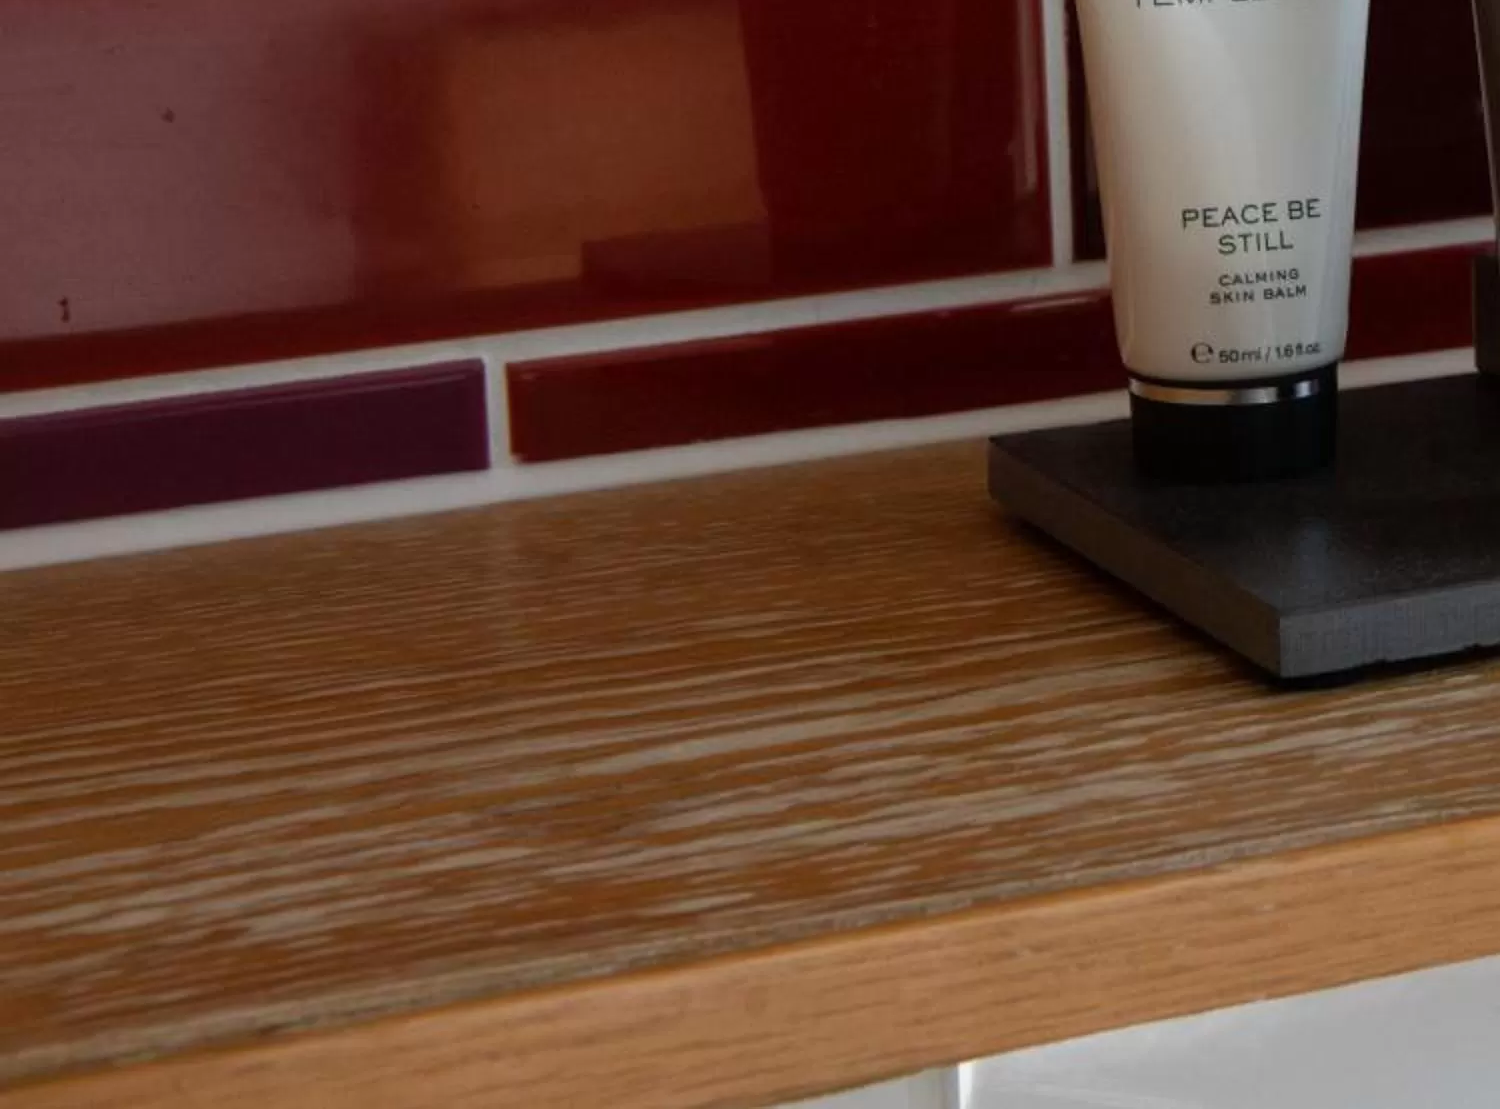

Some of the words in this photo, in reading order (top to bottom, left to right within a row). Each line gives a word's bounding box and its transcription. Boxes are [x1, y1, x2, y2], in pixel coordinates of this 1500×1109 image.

[1181, 202, 1278, 231] PEACE
[1288, 198, 1321, 221] BE
[1218, 231, 1294, 255] STILL
[1218, 268, 1300, 287] CALMING
[1209, 291, 1255, 305] SKIN
[1263, 285, 1307, 300] BALM
